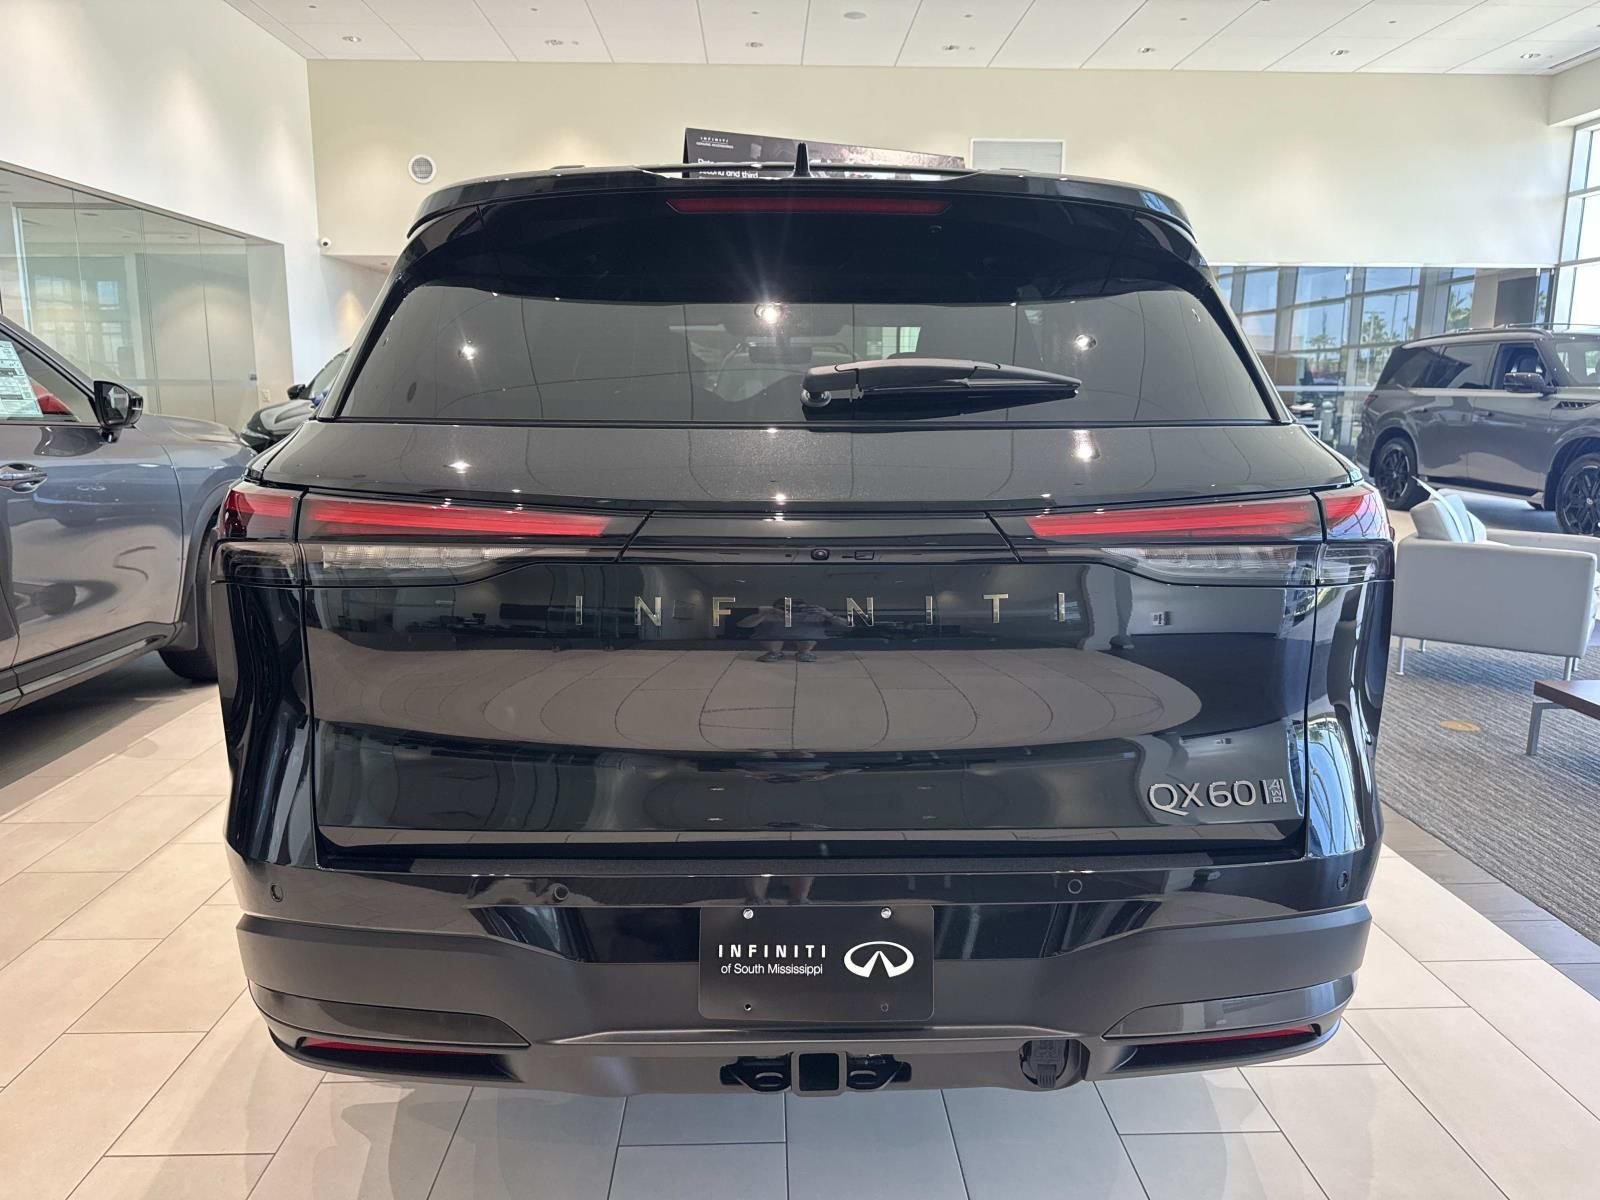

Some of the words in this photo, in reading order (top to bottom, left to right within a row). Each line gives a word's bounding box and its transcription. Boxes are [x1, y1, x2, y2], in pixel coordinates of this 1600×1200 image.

[726, 170, 741, 178] and
[741, 170, 759, 179] third
[575, 591, 1066, 628] INFINITI
[1149, 780, 1257, 816] QX60
[718, 944, 826, 958] INFINITI
[720, 963, 732, 974] of
[734, 963, 765, 974] South
[767, 963, 823, 976] Mississippi
